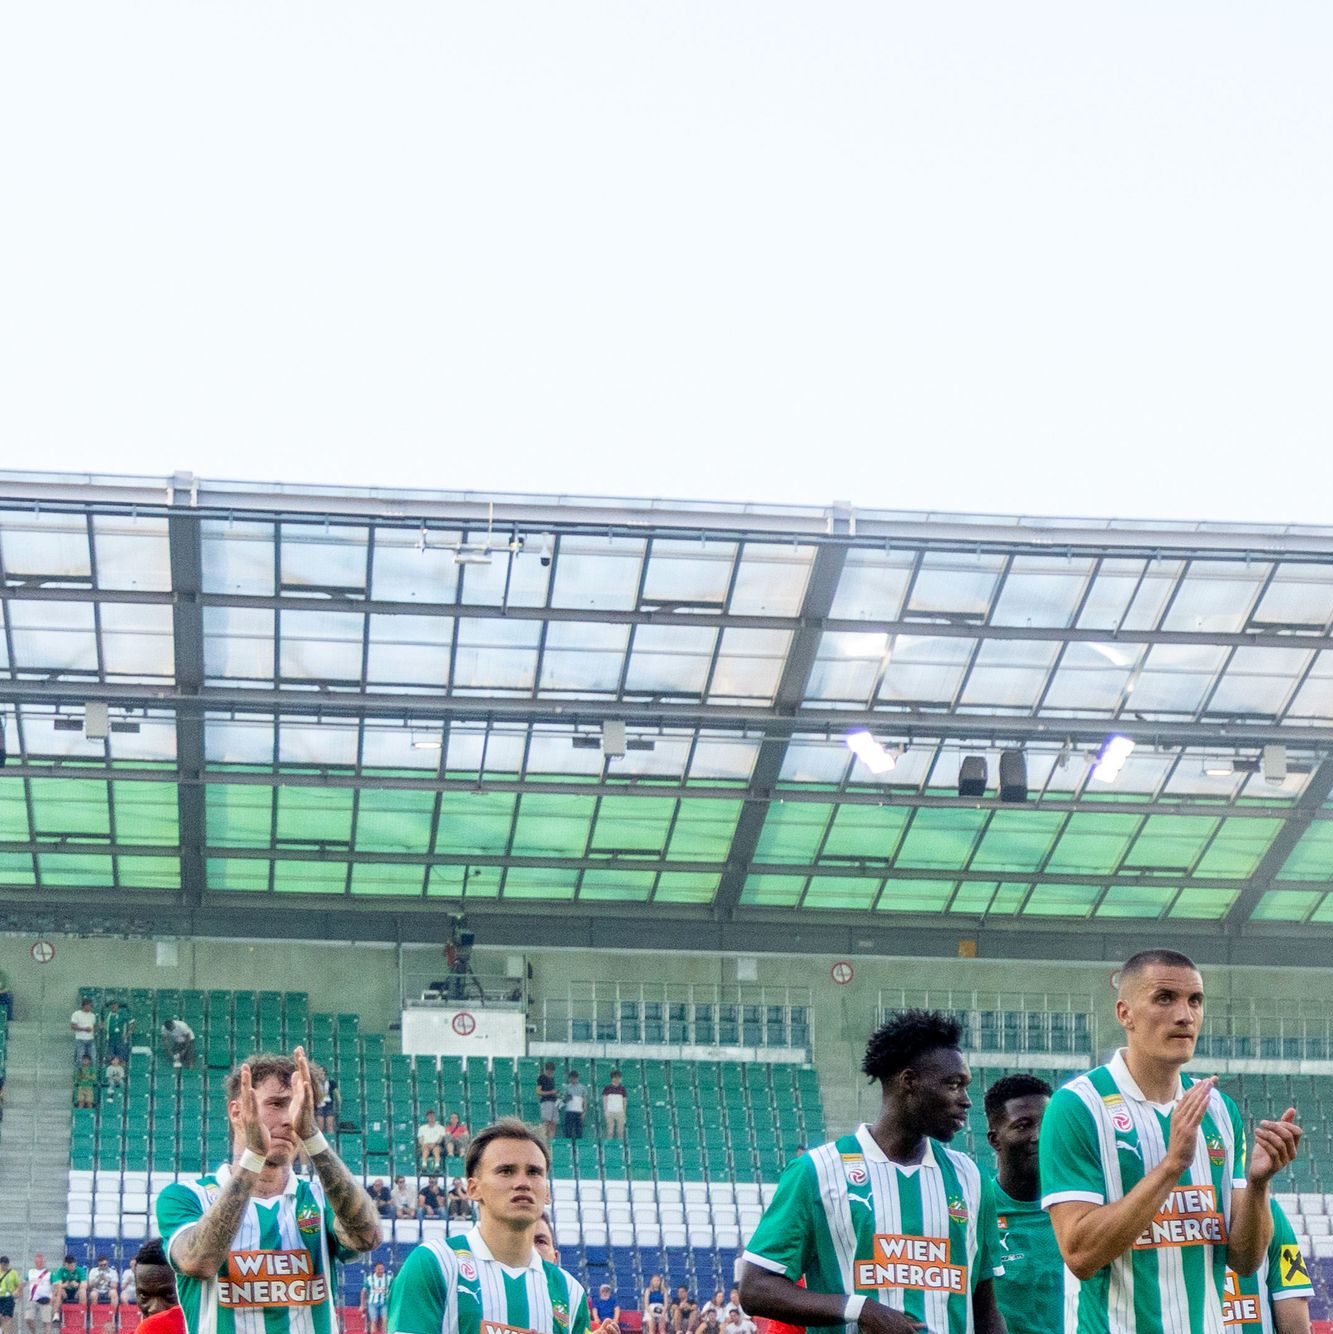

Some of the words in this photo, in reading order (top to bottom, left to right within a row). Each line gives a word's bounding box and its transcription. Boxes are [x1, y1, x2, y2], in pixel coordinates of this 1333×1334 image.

[879, 1237, 948, 1262] WIEN
[234, 1253, 310, 1277] WIEN
[859, 1262, 963, 1291] ENERGIE
[217, 1278, 327, 1304] ENERGIE
